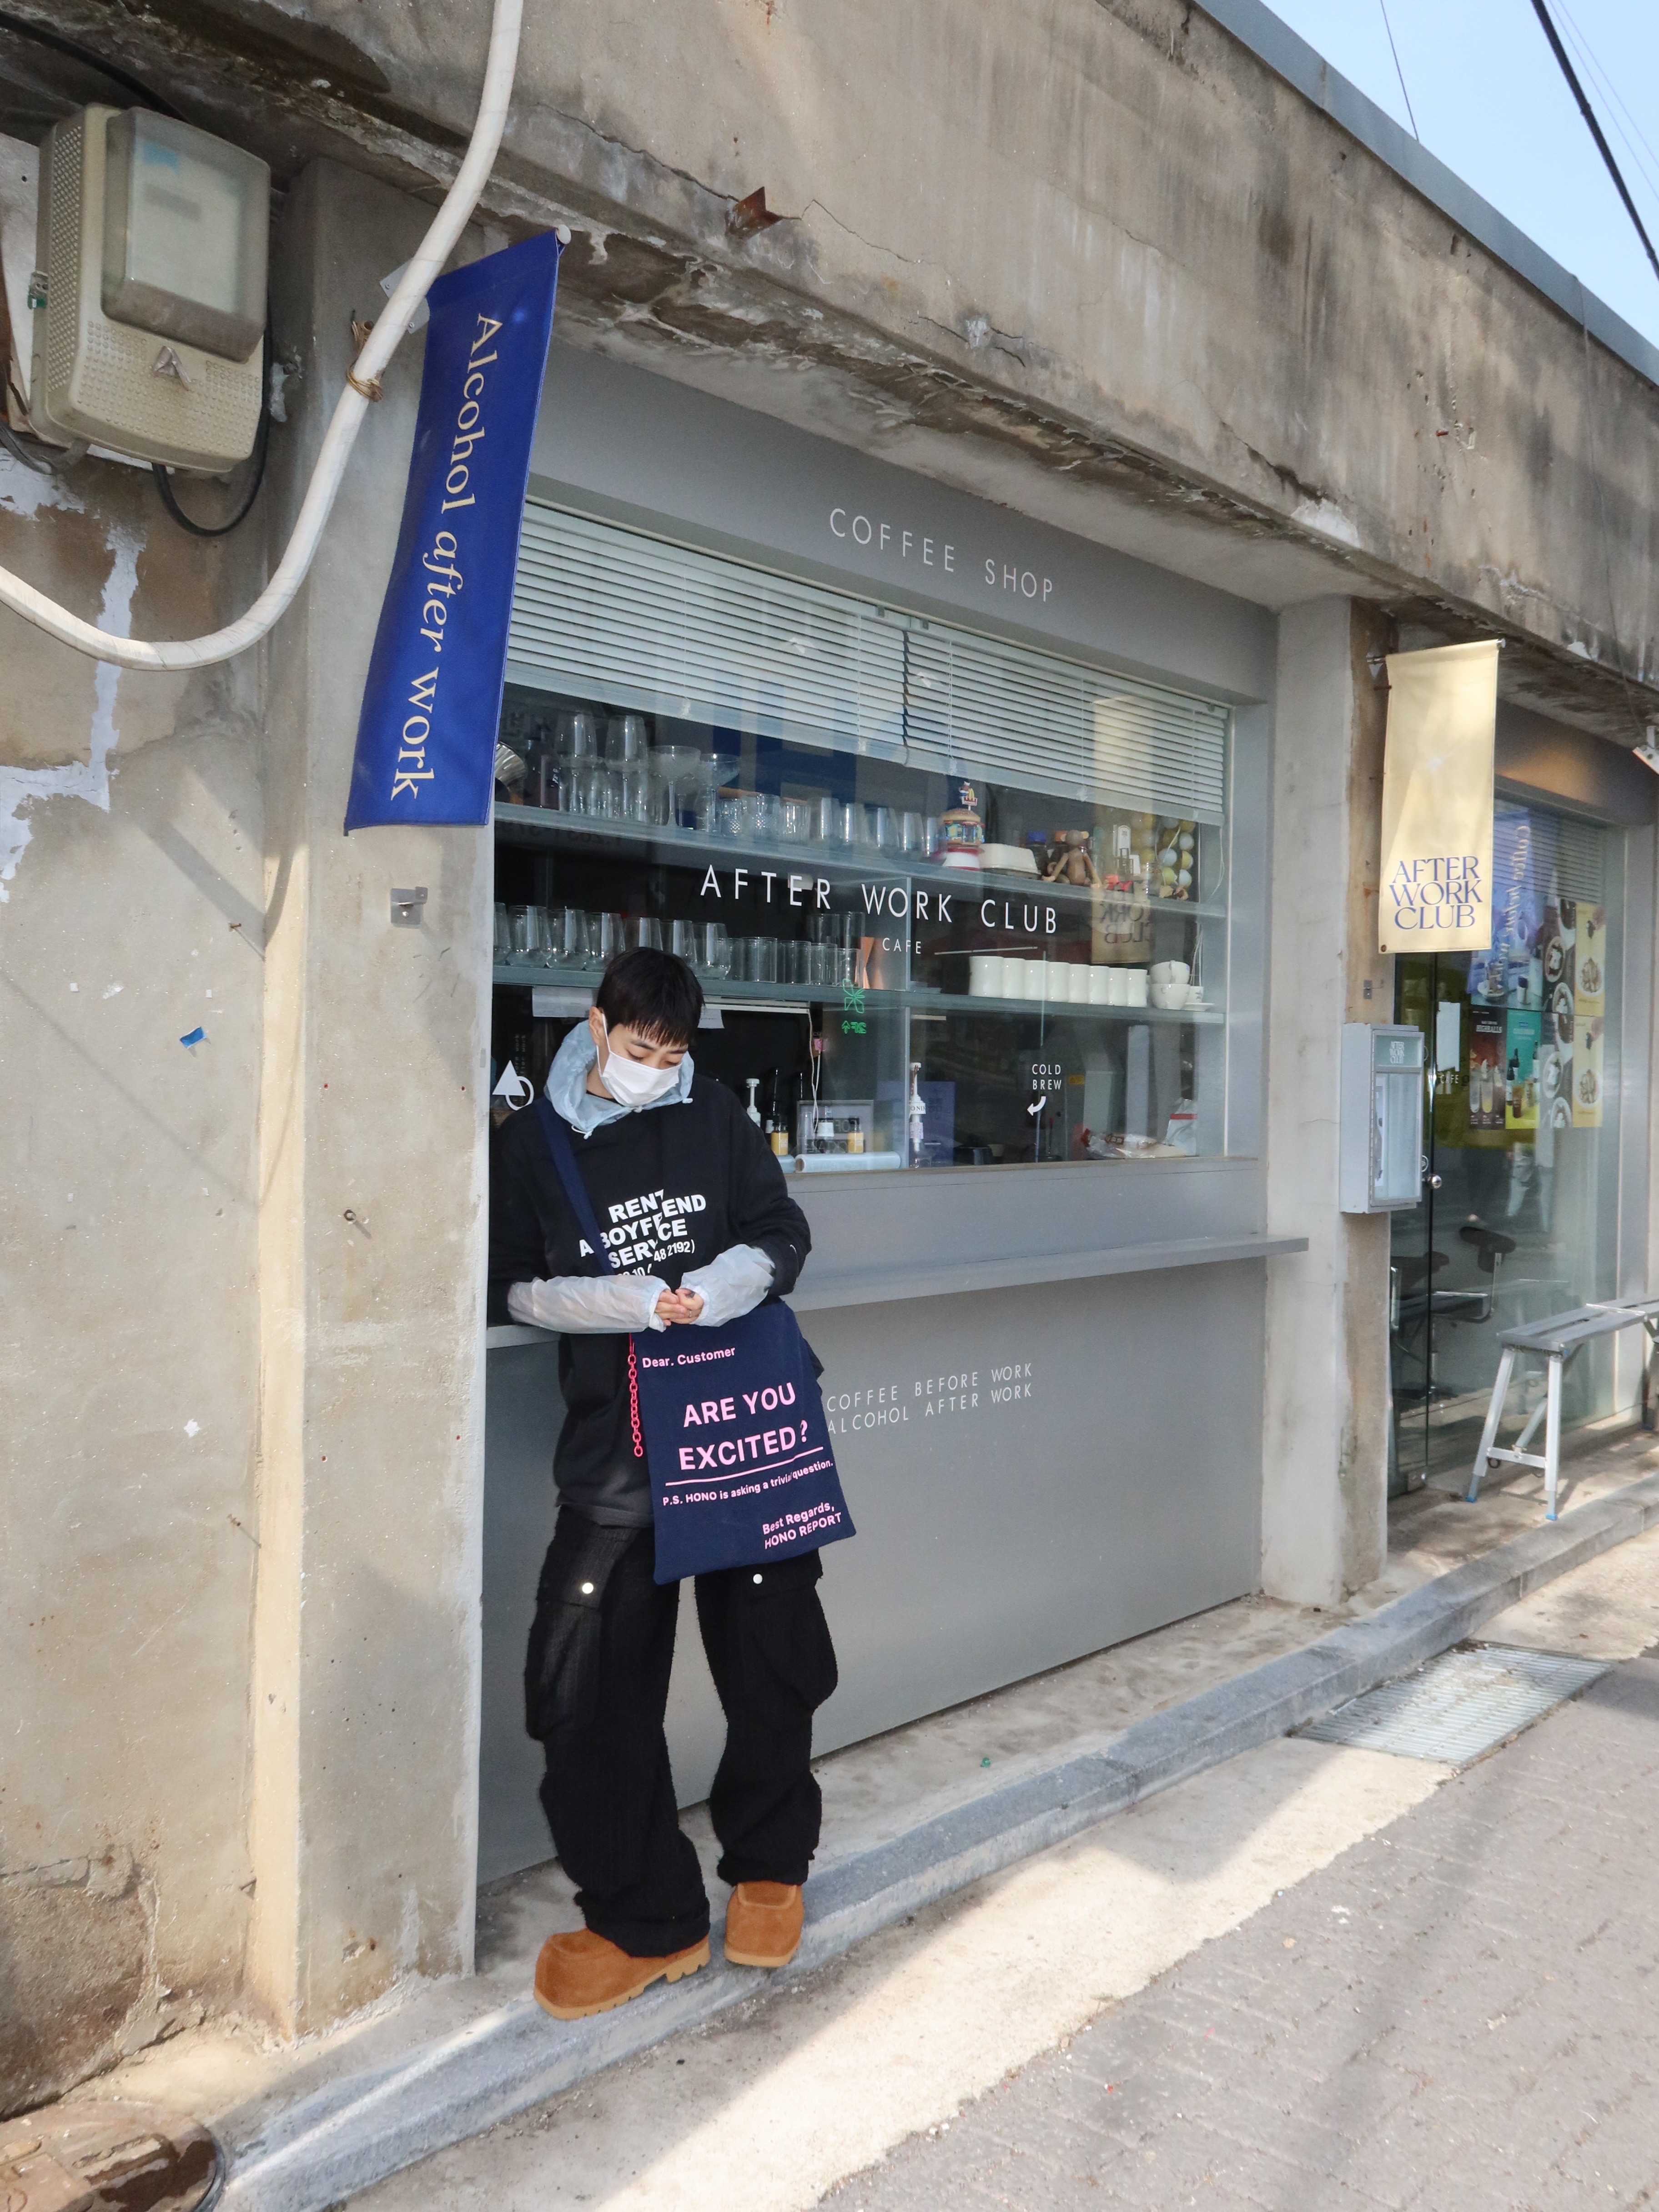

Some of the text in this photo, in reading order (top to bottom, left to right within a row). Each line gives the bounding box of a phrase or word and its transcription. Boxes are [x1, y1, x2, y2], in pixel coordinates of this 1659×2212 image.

[390, 312, 503, 802] Alcohol after work
[830, 508, 1053, 602] COFFEE SHOP
[1392, 855, 1481, 884] AFTER
[700, 864, 1057, 934] AFTER WORK CLUB
[1389, 879, 1483, 907] WORK
[1394, 905, 1476, 930] CLUB
[882, 937, 922, 955] CAFE
[1032, 1064, 1062, 1076] COLD
[1032, 1079, 1062, 1091] BREW
[579, 1239, 595, 1257] A
[642, 1346, 736, 1369] Dear. Customer
[683, 1382, 797, 1428] ARE YOU
[826, 1362, 1032, 1413] COFFEE BEFORE WORK
[827, 1382, 1032, 1435] ALCOHOL AFTER WORK
[679, 1419, 808, 1470] EXCITED?
[662, 1495, 684, 1506] P.S.
[685, 1491, 717, 1503] HONO
[719, 1490, 729, 1500] is
[731, 1483, 761, 1499] asking
[762, 1481, 769, 1490] a
[792, 1459, 834, 1481] question.
[762, 1501, 835, 1536] Best Regards,
[764, 1512, 842, 1550] HONO REPORT
